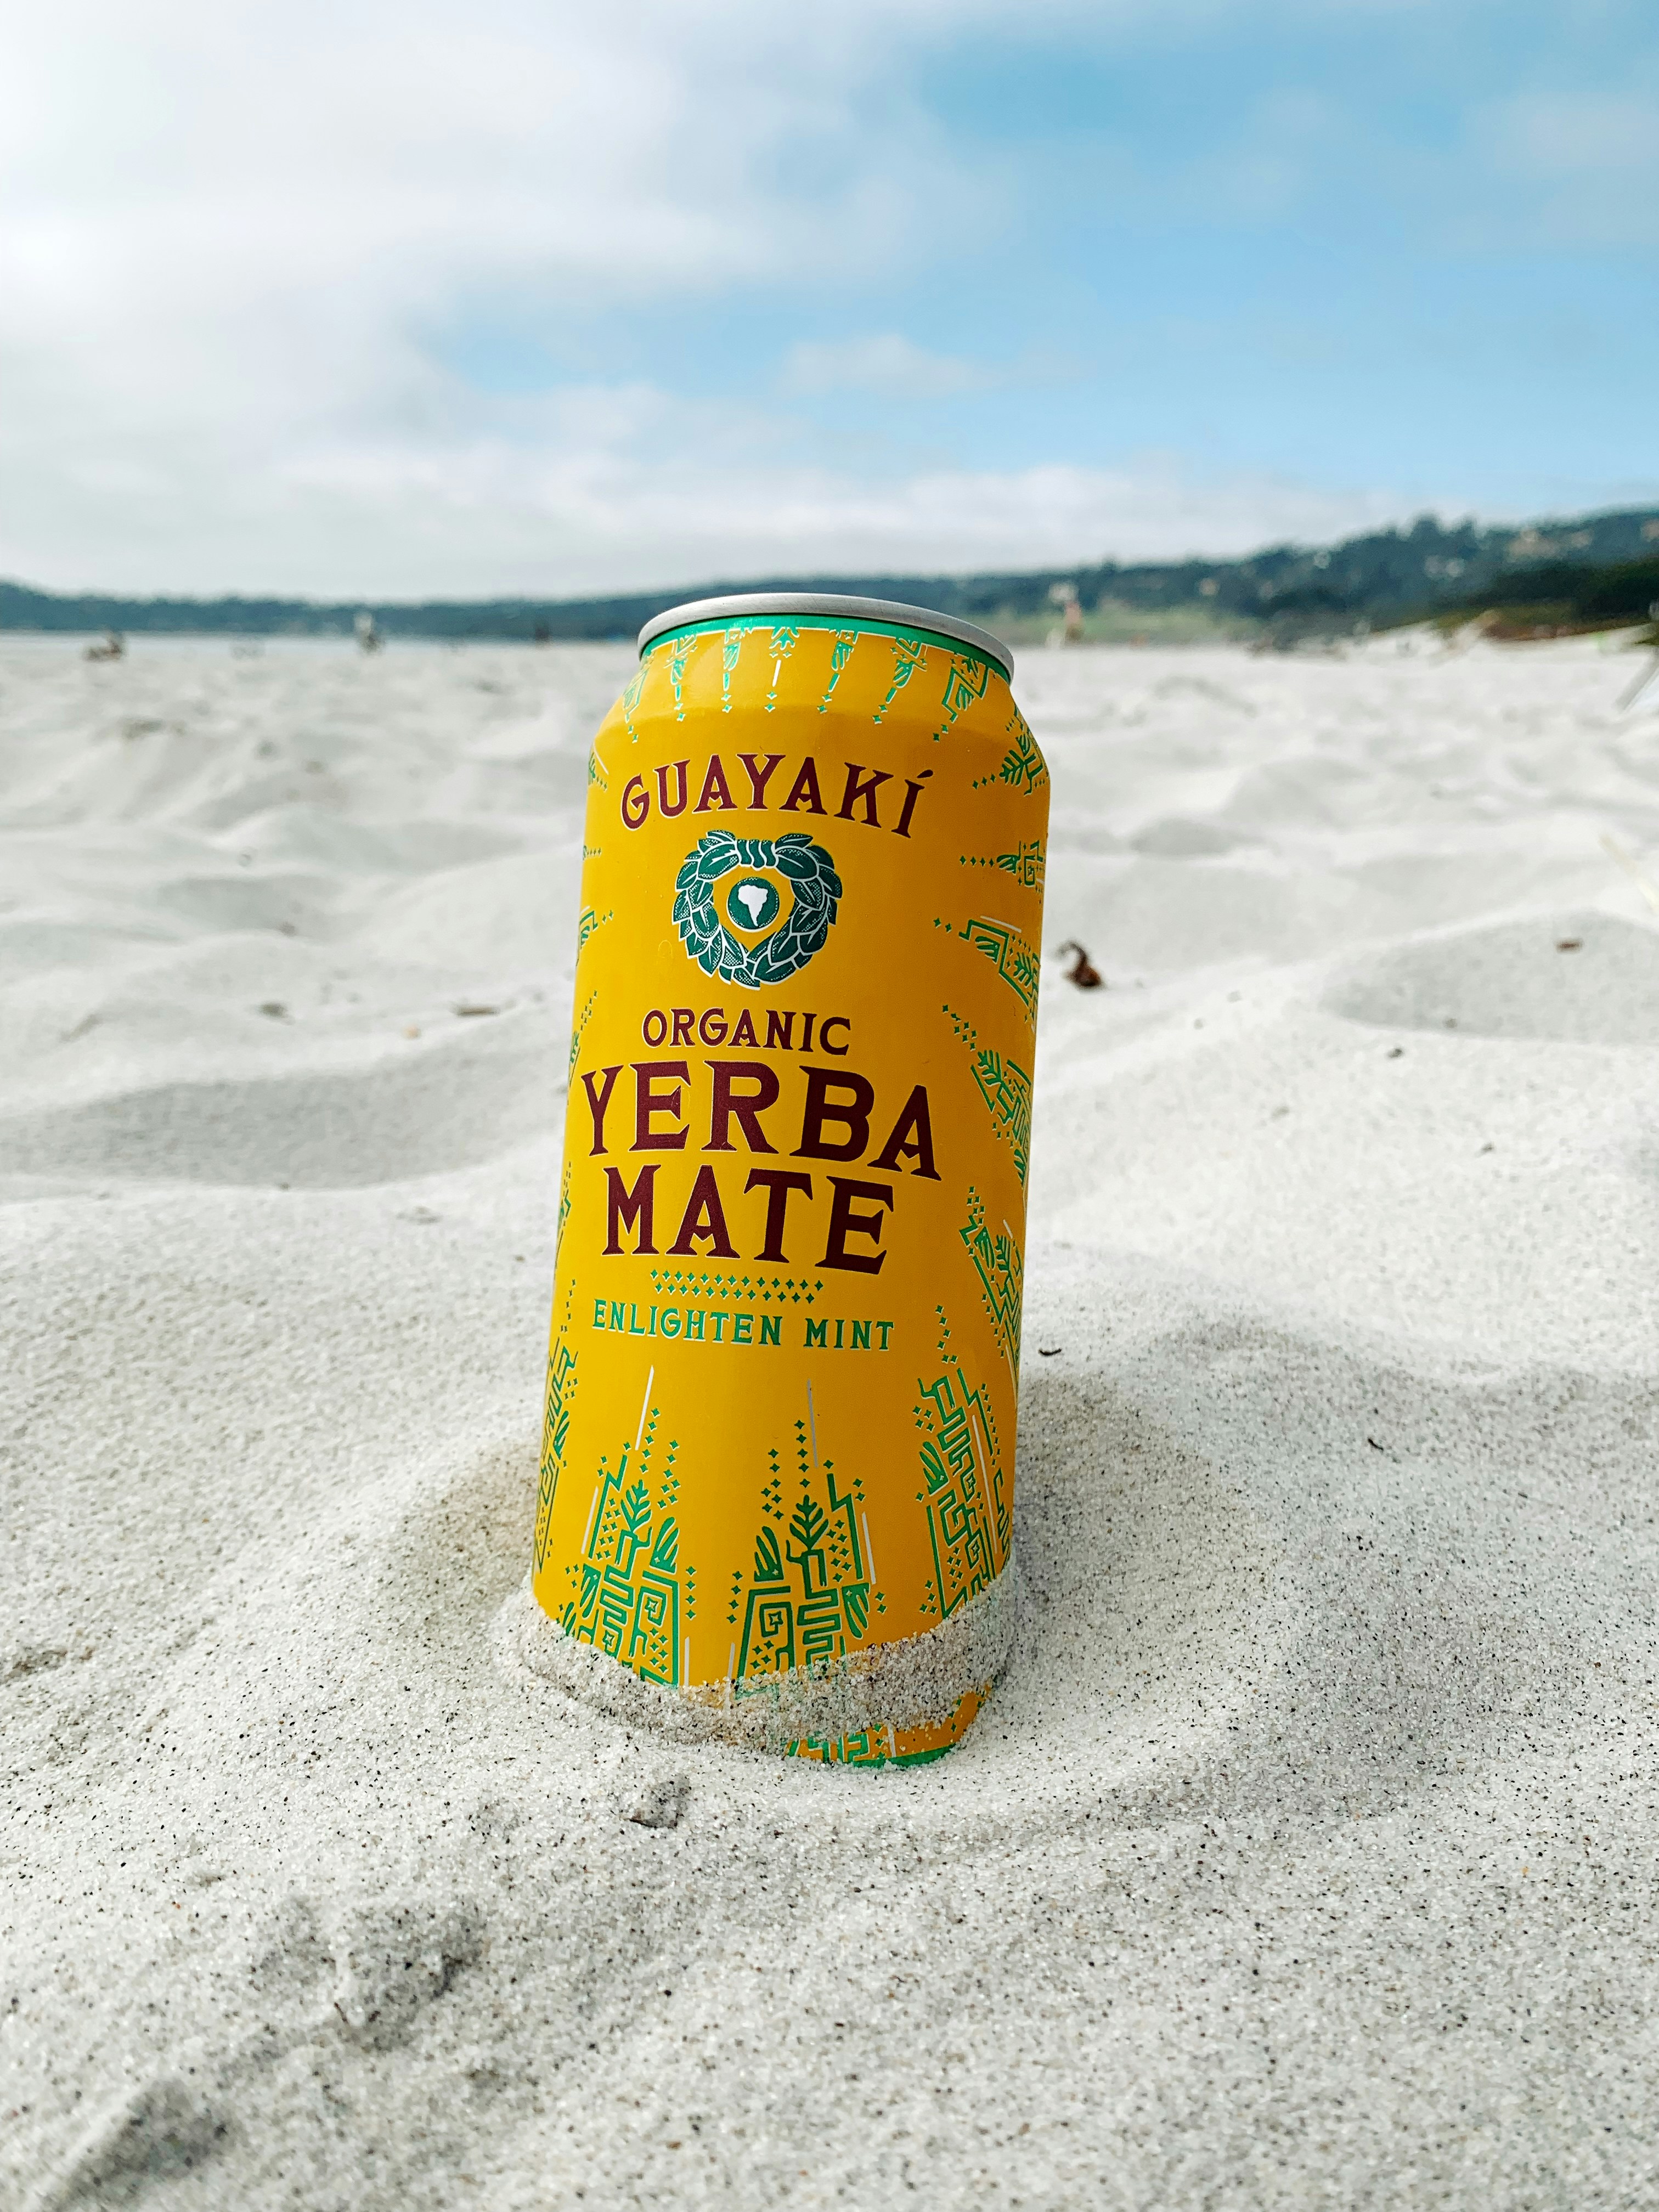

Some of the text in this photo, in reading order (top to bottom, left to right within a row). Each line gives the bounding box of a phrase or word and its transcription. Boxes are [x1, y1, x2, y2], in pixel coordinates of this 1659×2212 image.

[621, 754, 934, 839] GUAYAKÍ
[642, 1008, 851, 1056] ORGANIC
[581, 1060, 942, 1181] YERBA
[601, 1164, 894, 1275] MATE
[592, 1298, 894, 1351] ENLIGHTEN MINT
